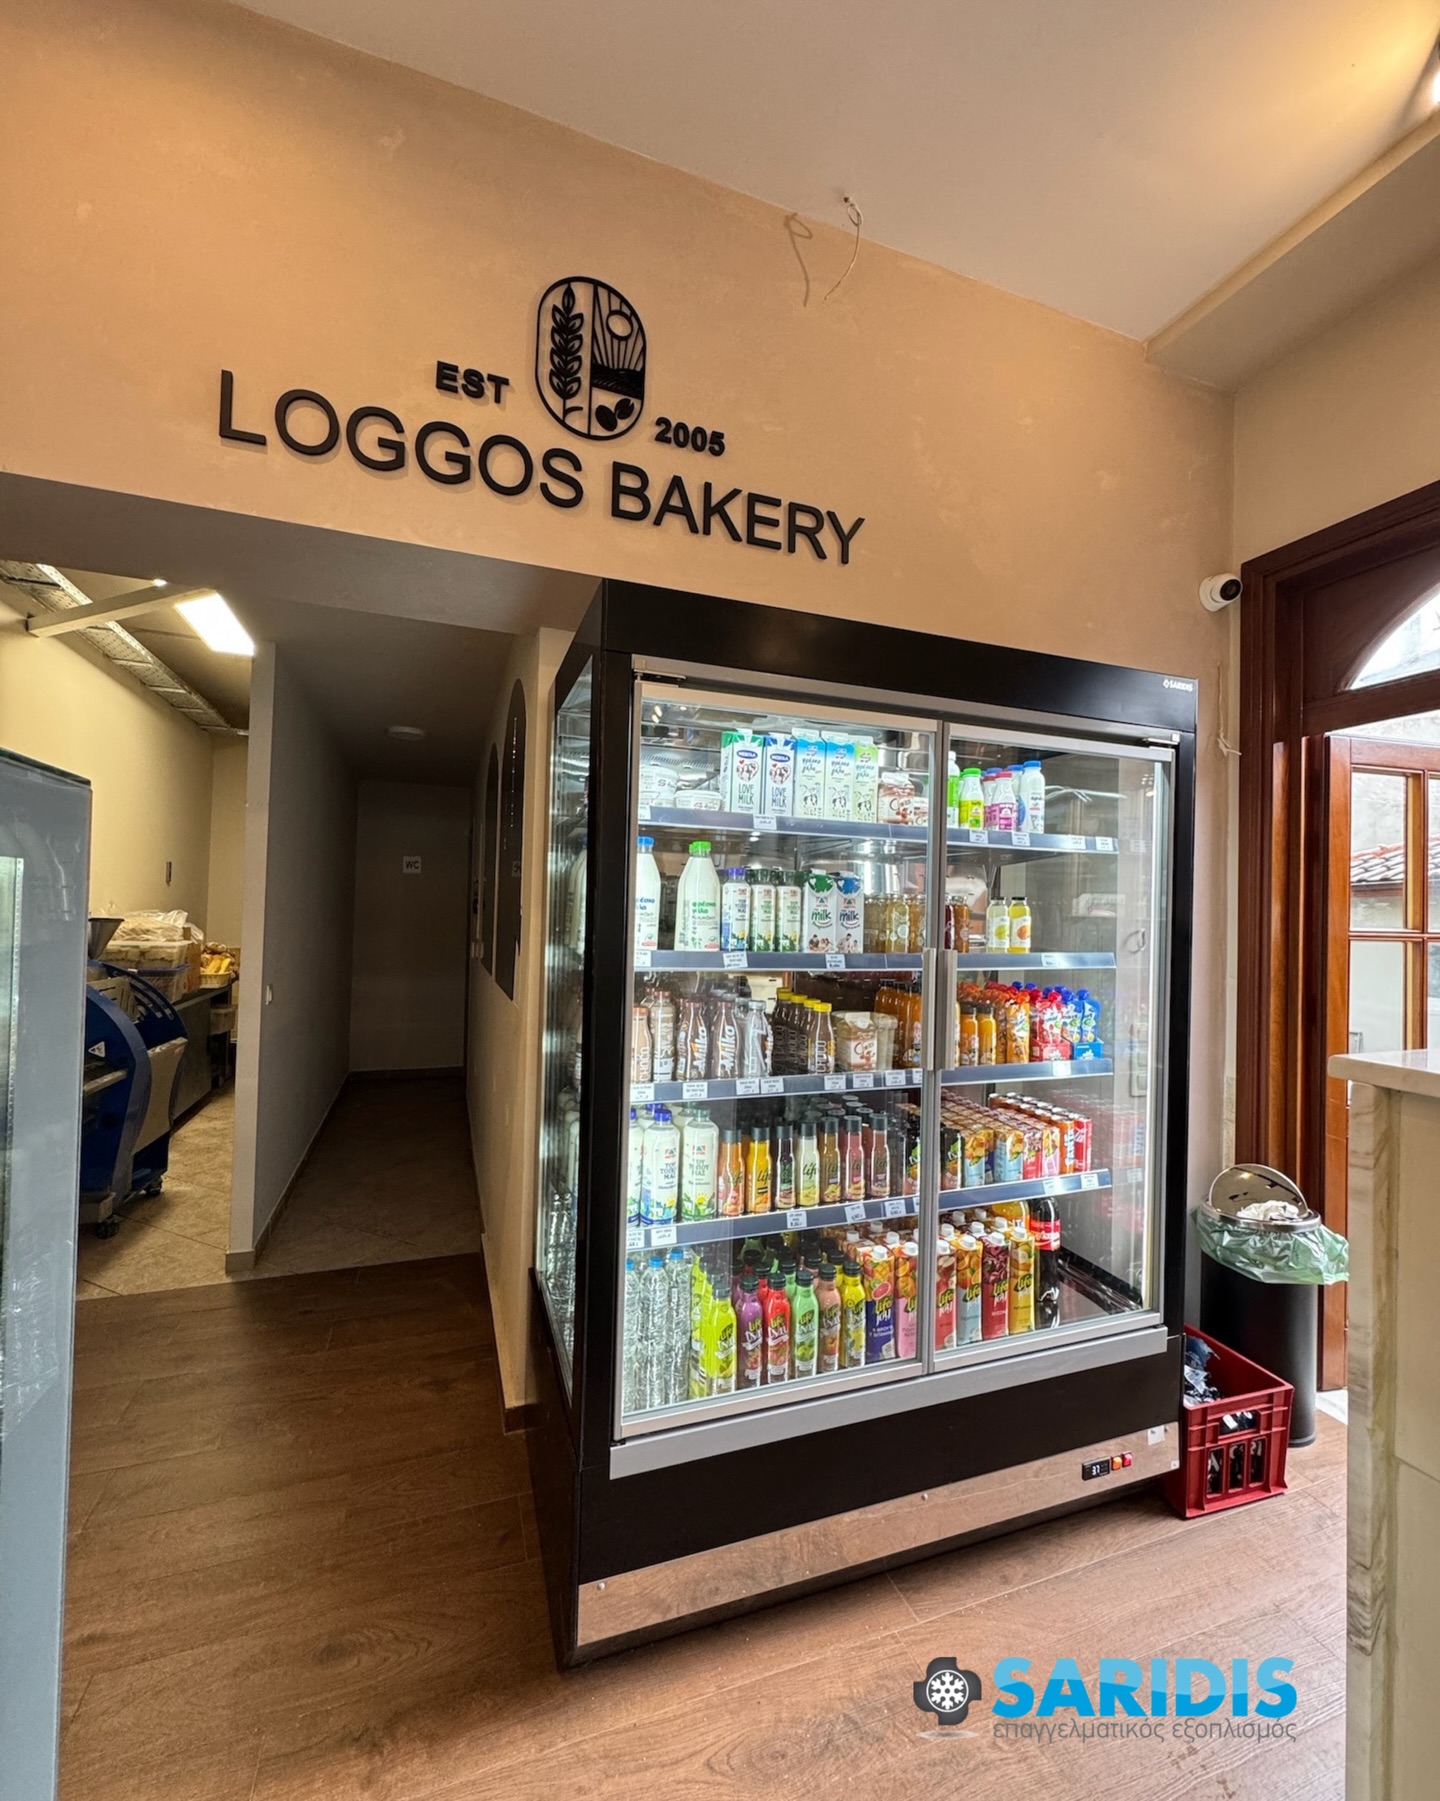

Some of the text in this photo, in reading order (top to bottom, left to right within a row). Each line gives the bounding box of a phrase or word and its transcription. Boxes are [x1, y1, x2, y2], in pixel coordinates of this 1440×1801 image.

[435, 360, 510, 404] EST
[655, 417, 726, 457] 2005
[219, 369, 865, 565] LOGGOS BAKERY
[738, 783, 754, 794] LOVE
[771, 786, 787, 797] LOVE
[738, 794, 754, 805] MILK
[771, 797, 787, 807] MILK
[405, 860, 420, 870] WC
[811, 907, 832, 921] milk
[839, 909, 860, 922] milk
[720, 1024, 736, 1074] Milko
[1018, 1275, 1032, 1291] Life
[938, 1287, 954, 1307] Life
[770, 1314, 783, 1329] Life
[799, 1311, 813, 1325] Life
